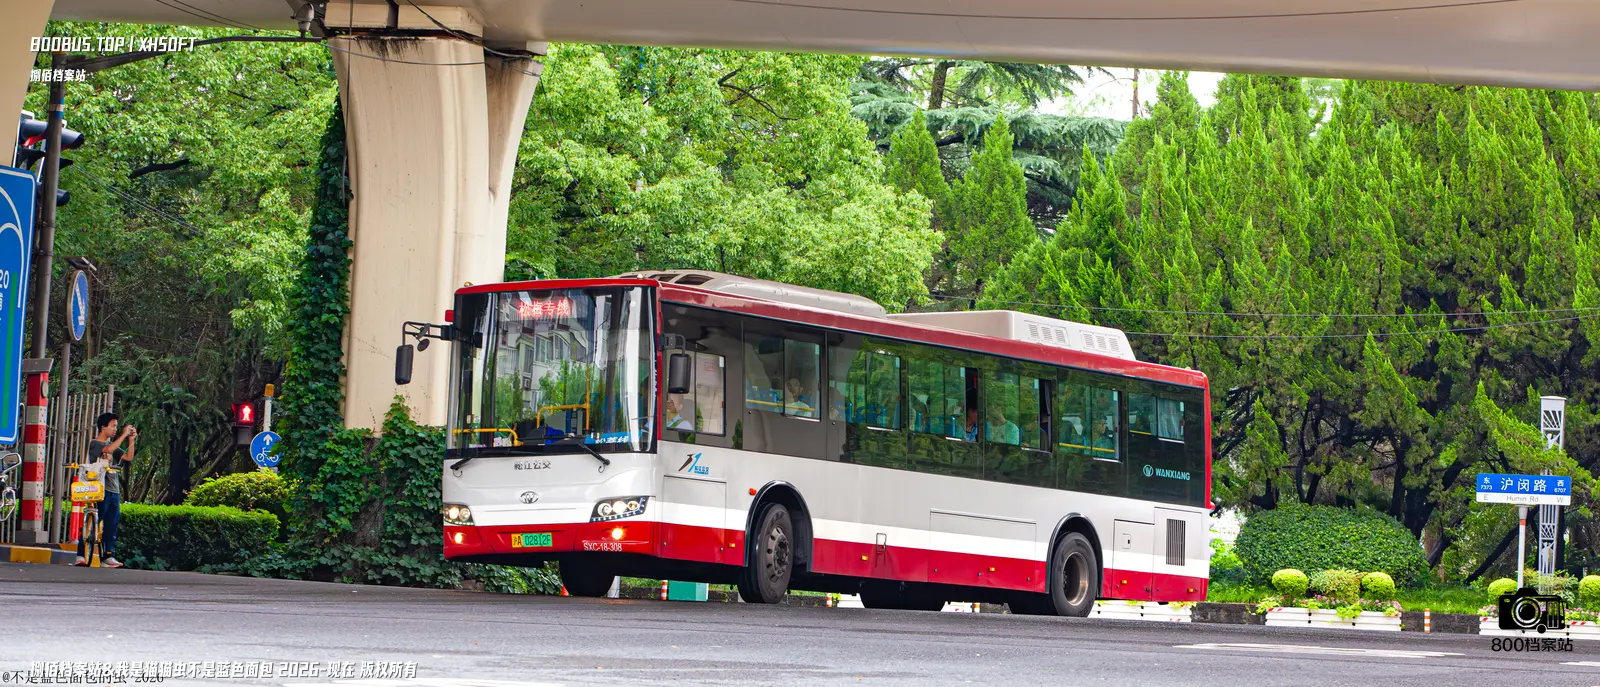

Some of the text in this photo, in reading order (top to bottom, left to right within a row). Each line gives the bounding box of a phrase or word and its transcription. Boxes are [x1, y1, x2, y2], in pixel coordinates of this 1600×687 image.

[518, 298, 570, 318] 松梅专线
[1155, 467, 1190, 480] WANXIANG
[1500, 478, 1546, 492] 沪闵路
[583, 542, 622, 552] SXC-18-308
